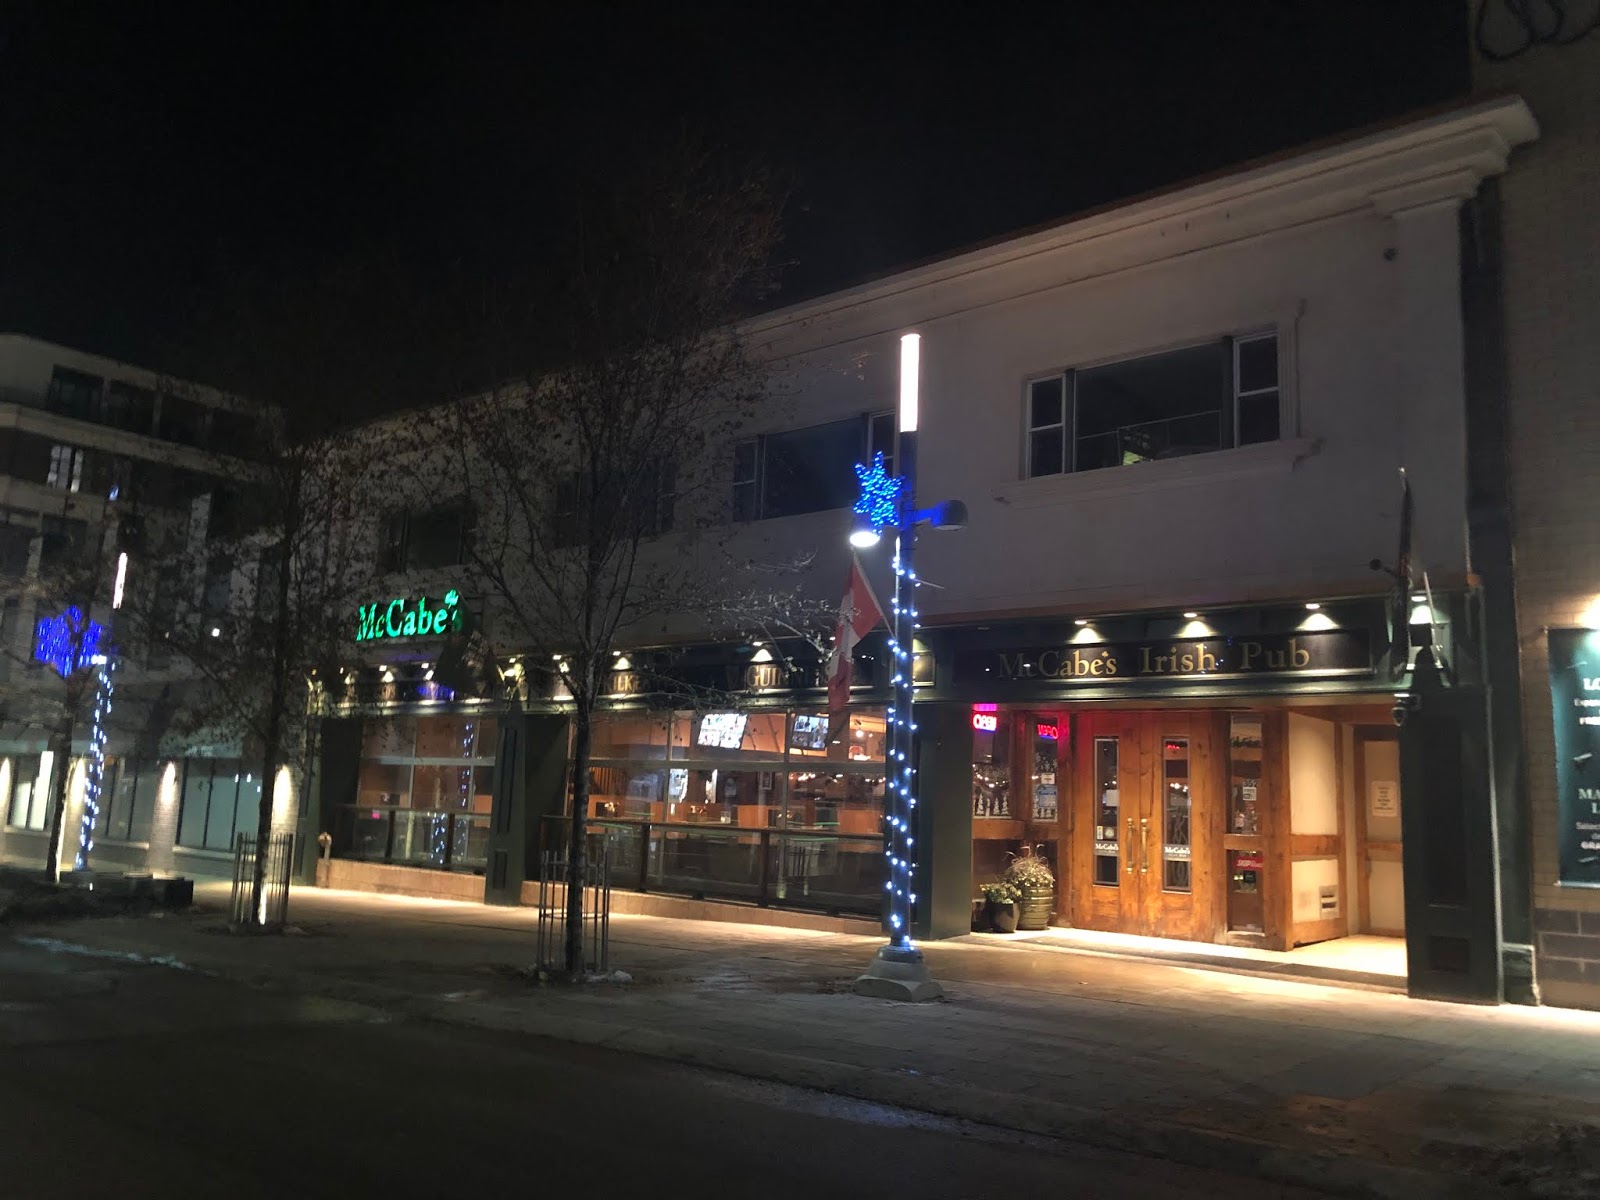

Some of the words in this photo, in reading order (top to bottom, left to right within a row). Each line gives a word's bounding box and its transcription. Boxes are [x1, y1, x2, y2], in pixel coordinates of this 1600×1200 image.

[1000, 649, 1118, 680] McCabe's
[1139, 643, 1218, 675] Irish
[1240, 637, 1311, 669] Pub
[973, 714, 997, 732] OPEN
